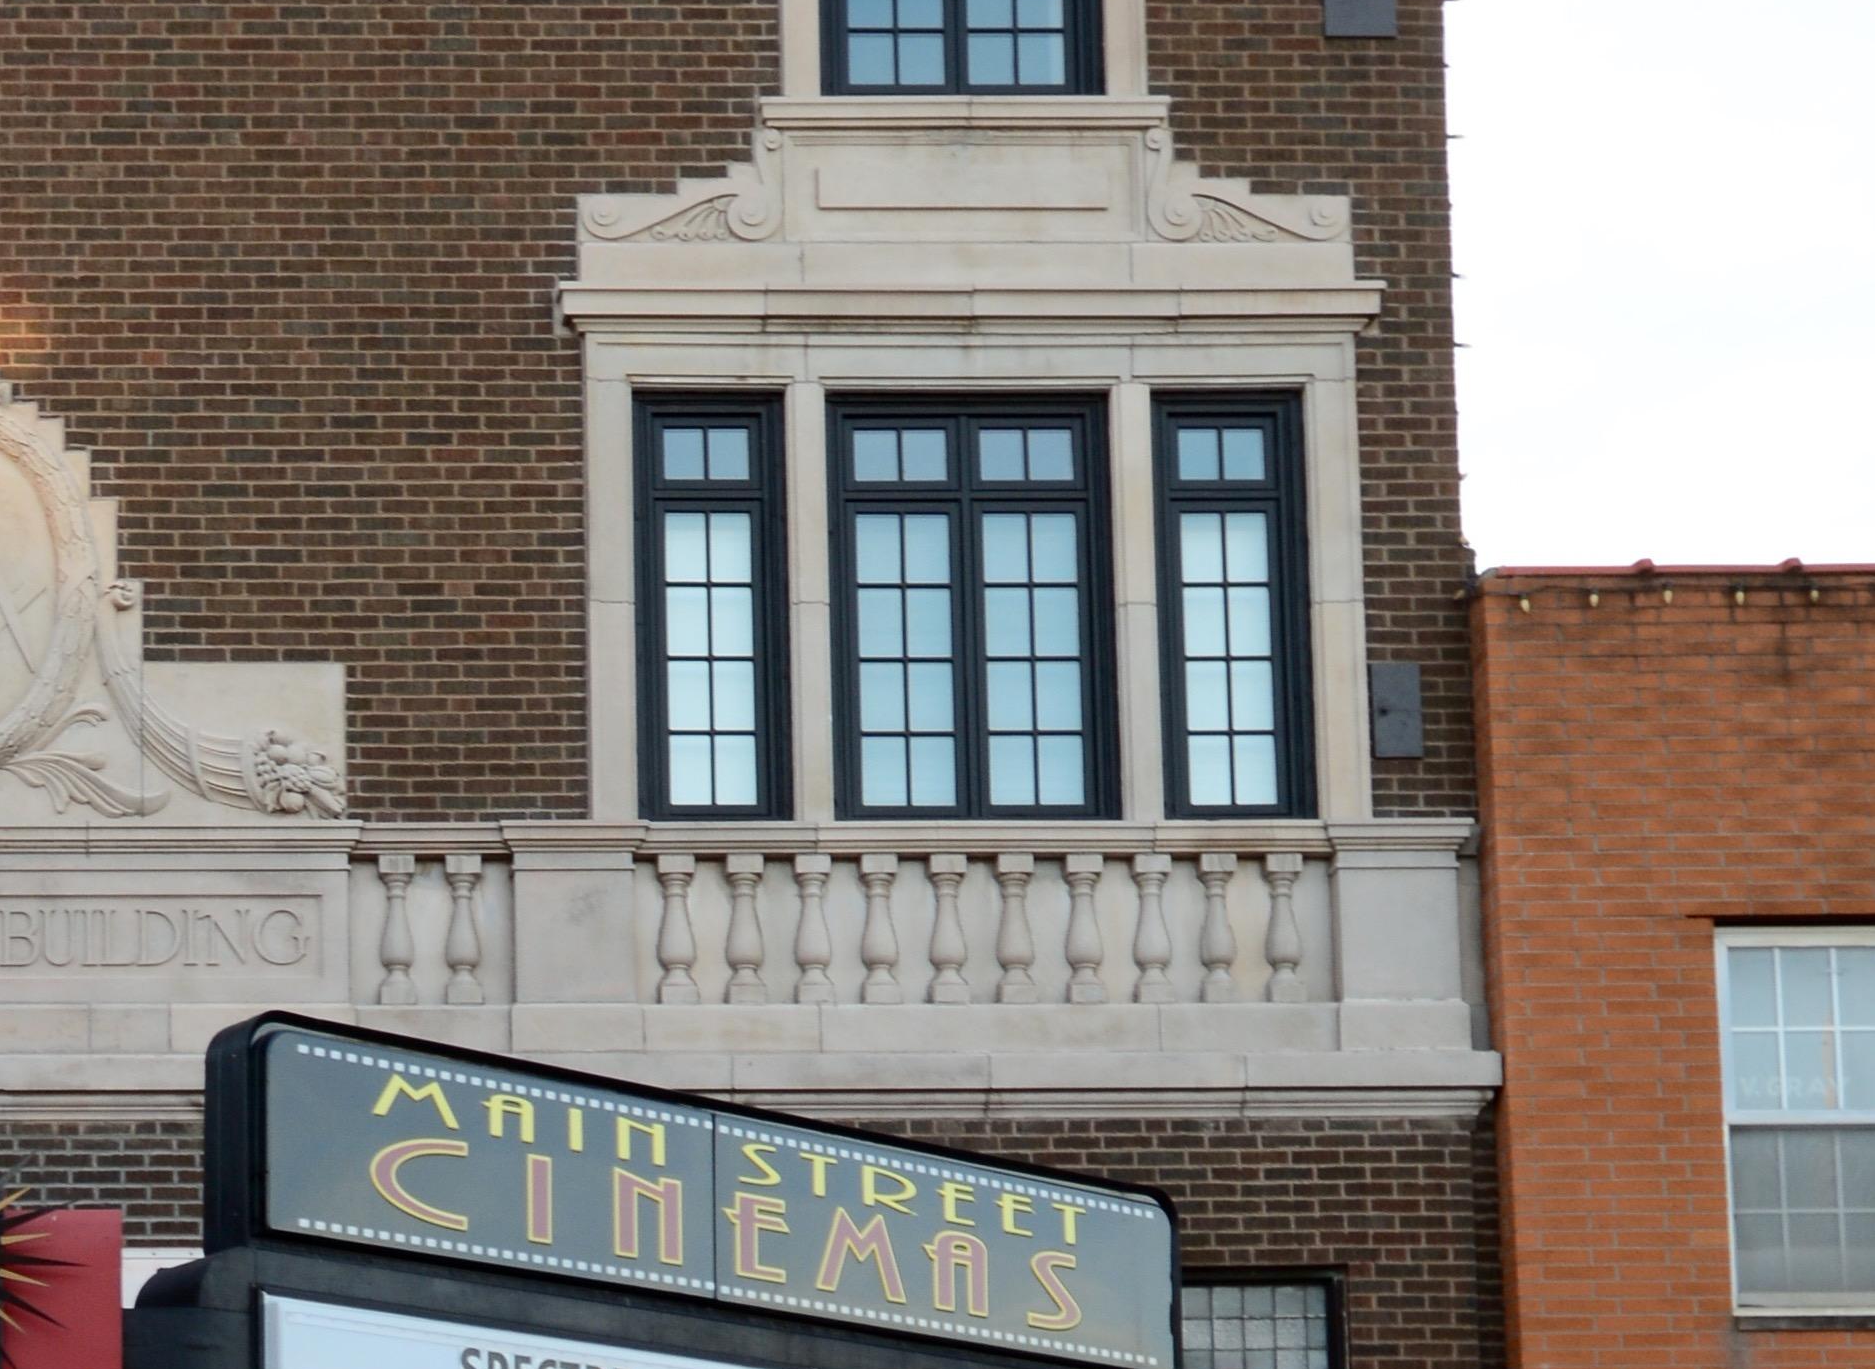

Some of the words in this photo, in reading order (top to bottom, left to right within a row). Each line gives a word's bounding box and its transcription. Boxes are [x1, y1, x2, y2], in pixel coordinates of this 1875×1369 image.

[370, 1137, 1082, 1331] CINEMAS
[373, 1074, 666, 1167] MAIN
[737, 1143, 1087, 1246] STREET
